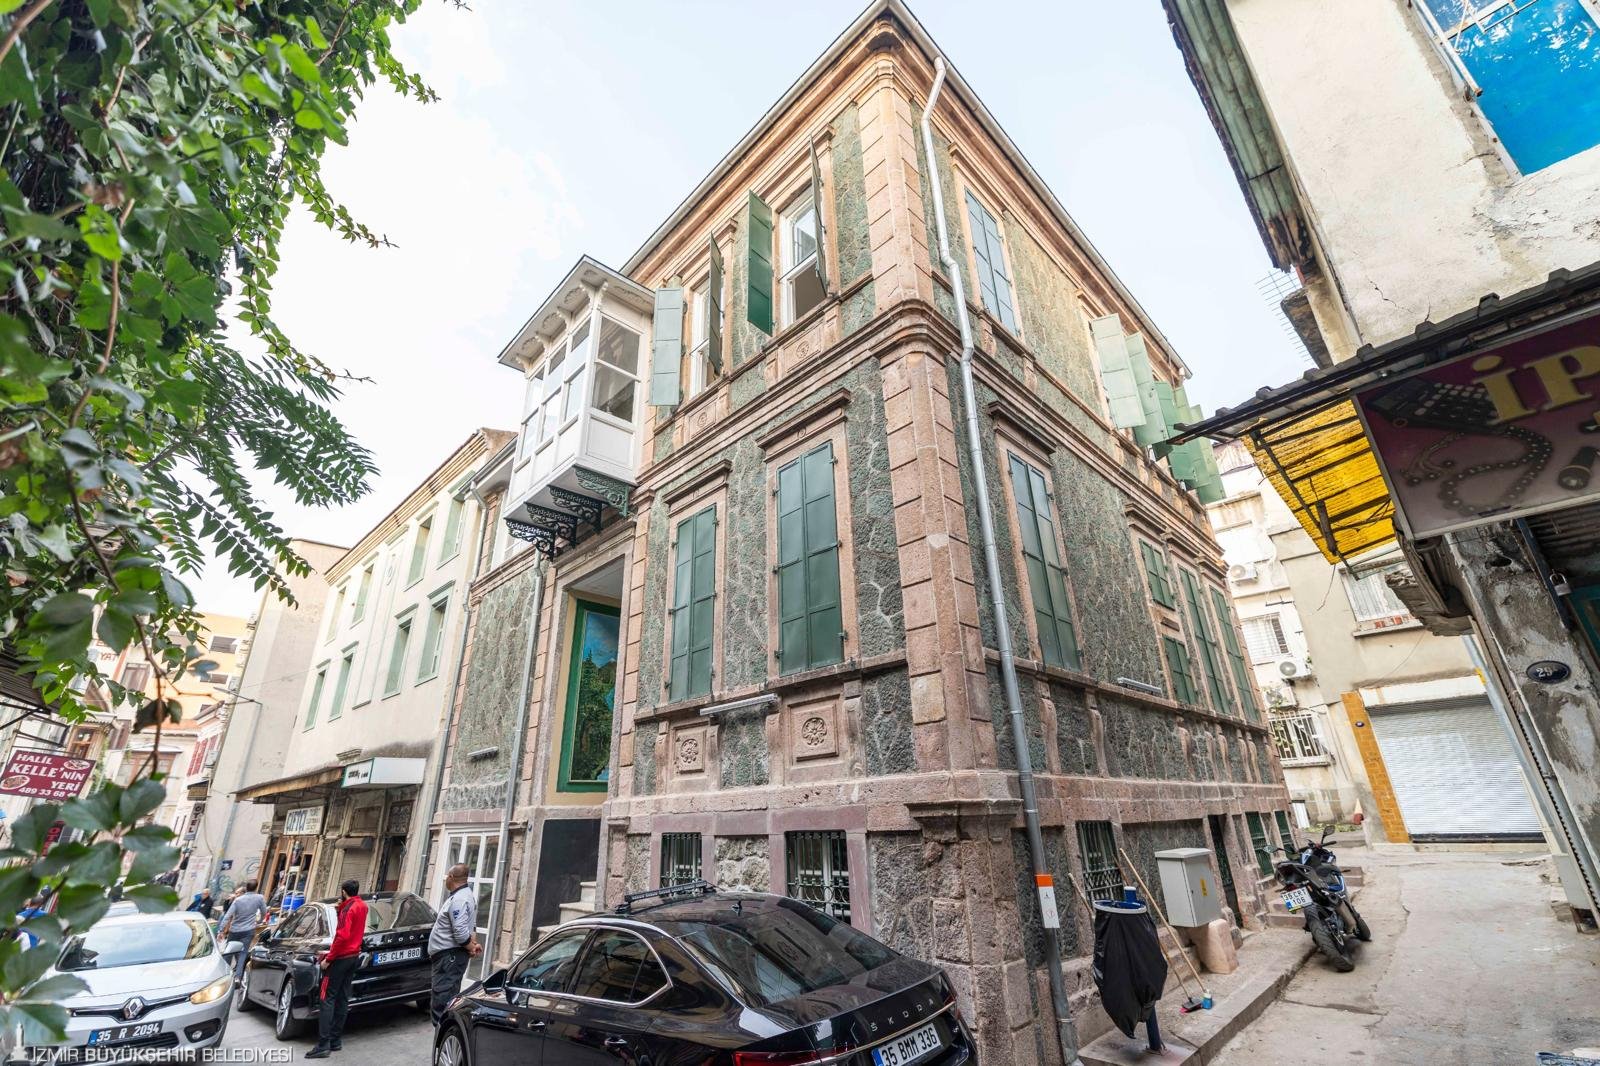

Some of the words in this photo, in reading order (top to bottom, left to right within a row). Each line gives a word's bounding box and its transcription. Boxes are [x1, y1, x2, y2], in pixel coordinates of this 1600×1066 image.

[16, 753, 53, 765] HALİL
[50, 780, 82, 791] YERİ
[188, 805, 202, 833] OTEL
[97, 1029, 111, 1042] 35
[119, 1028, 126, 1039] R
[133, 1022, 160, 1037] 2094
[882, 1047, 898, 1066] 35
[898, 1035, 920, 1060] BMM
[918, 1027, 938, 1050] 336
